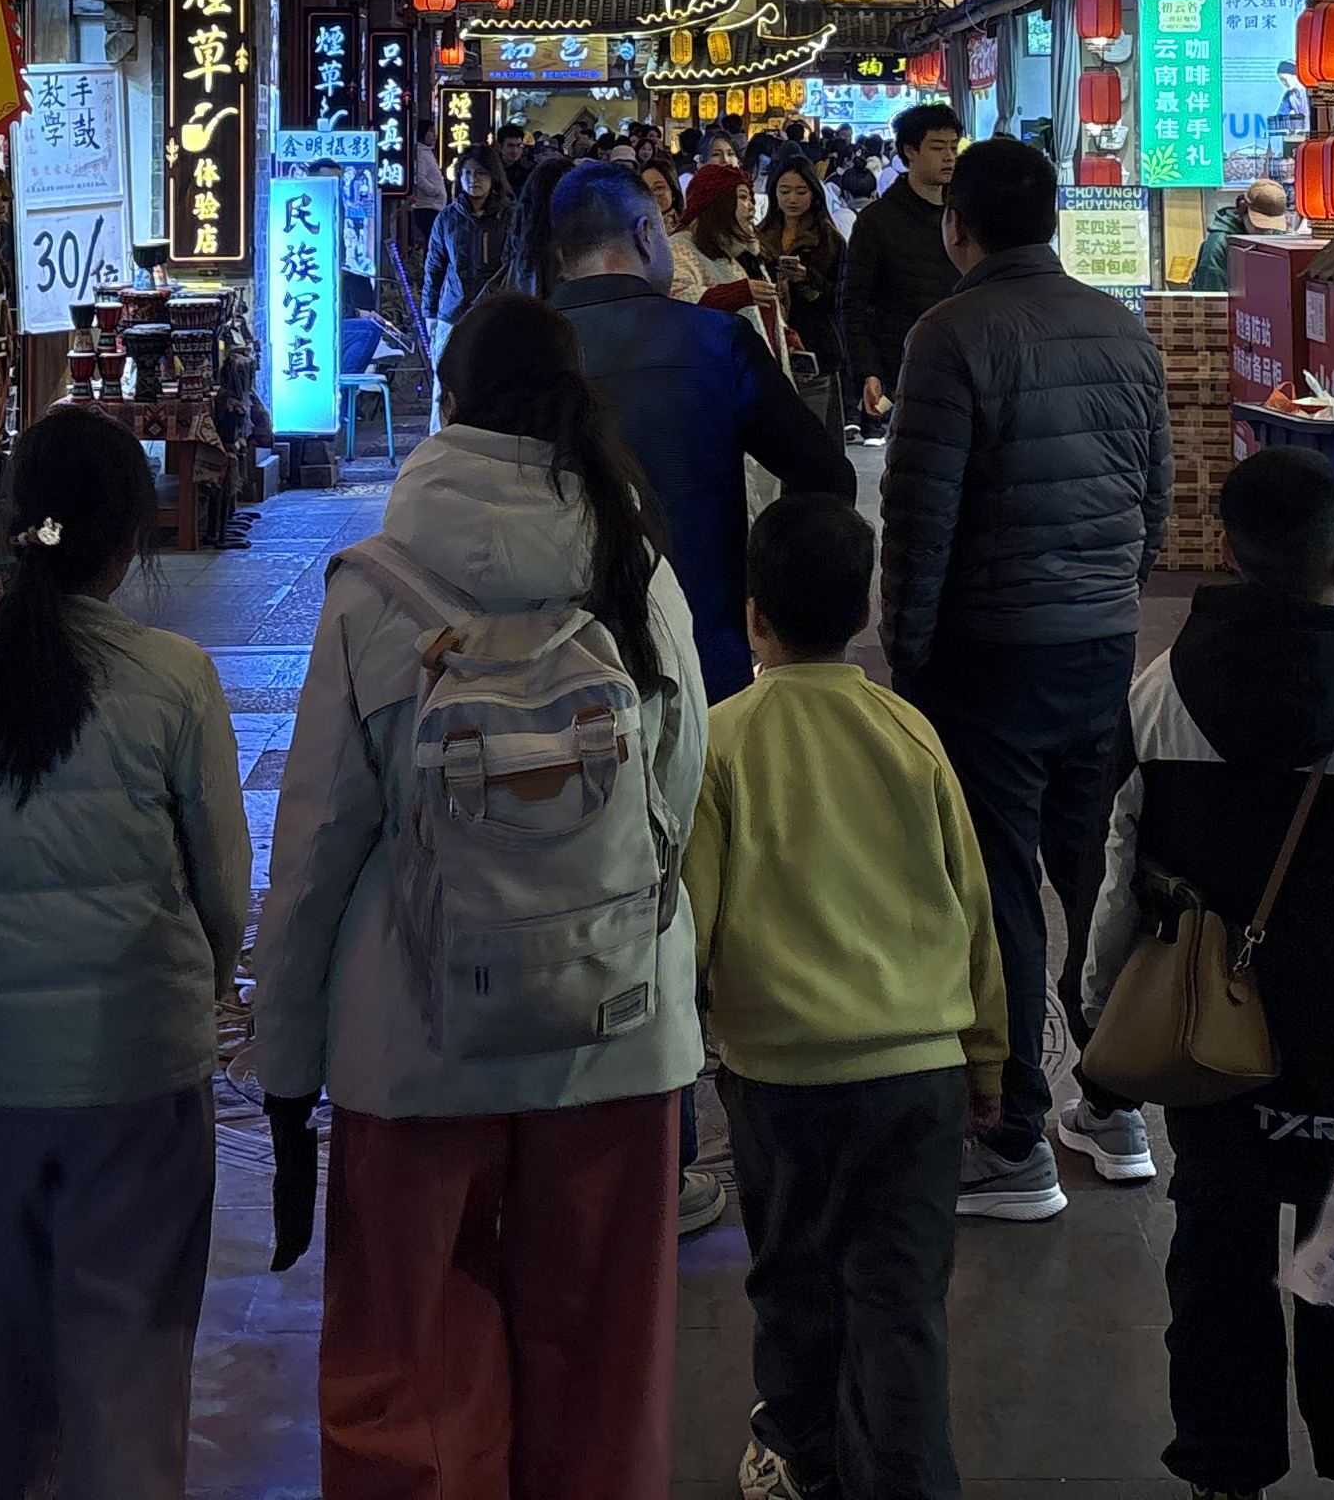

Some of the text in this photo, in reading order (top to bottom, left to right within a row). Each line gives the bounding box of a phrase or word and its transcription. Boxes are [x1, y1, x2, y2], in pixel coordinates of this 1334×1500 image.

[1226, 15, 1278, 30] 带回家
[1153, 39, 1180, 140] 云南最佳
[1185, 38, 1211, 167] 咖啡伴手礼
[377, 43, 404, 186] 只卖真烟
[1065, 187, 1142, 198] CHUYUNGU
[192, 159, 222, 255] 体验店
[1066, 199, 1142, 210] CHUYUNGU
[1075, 220, 1137, 235] 买四送一
[1075, 239, 1137, 255] 买六送二
[1075, 259, 1137, 275] 全国包邮
[279, 192, 323, 382] 民族写真
